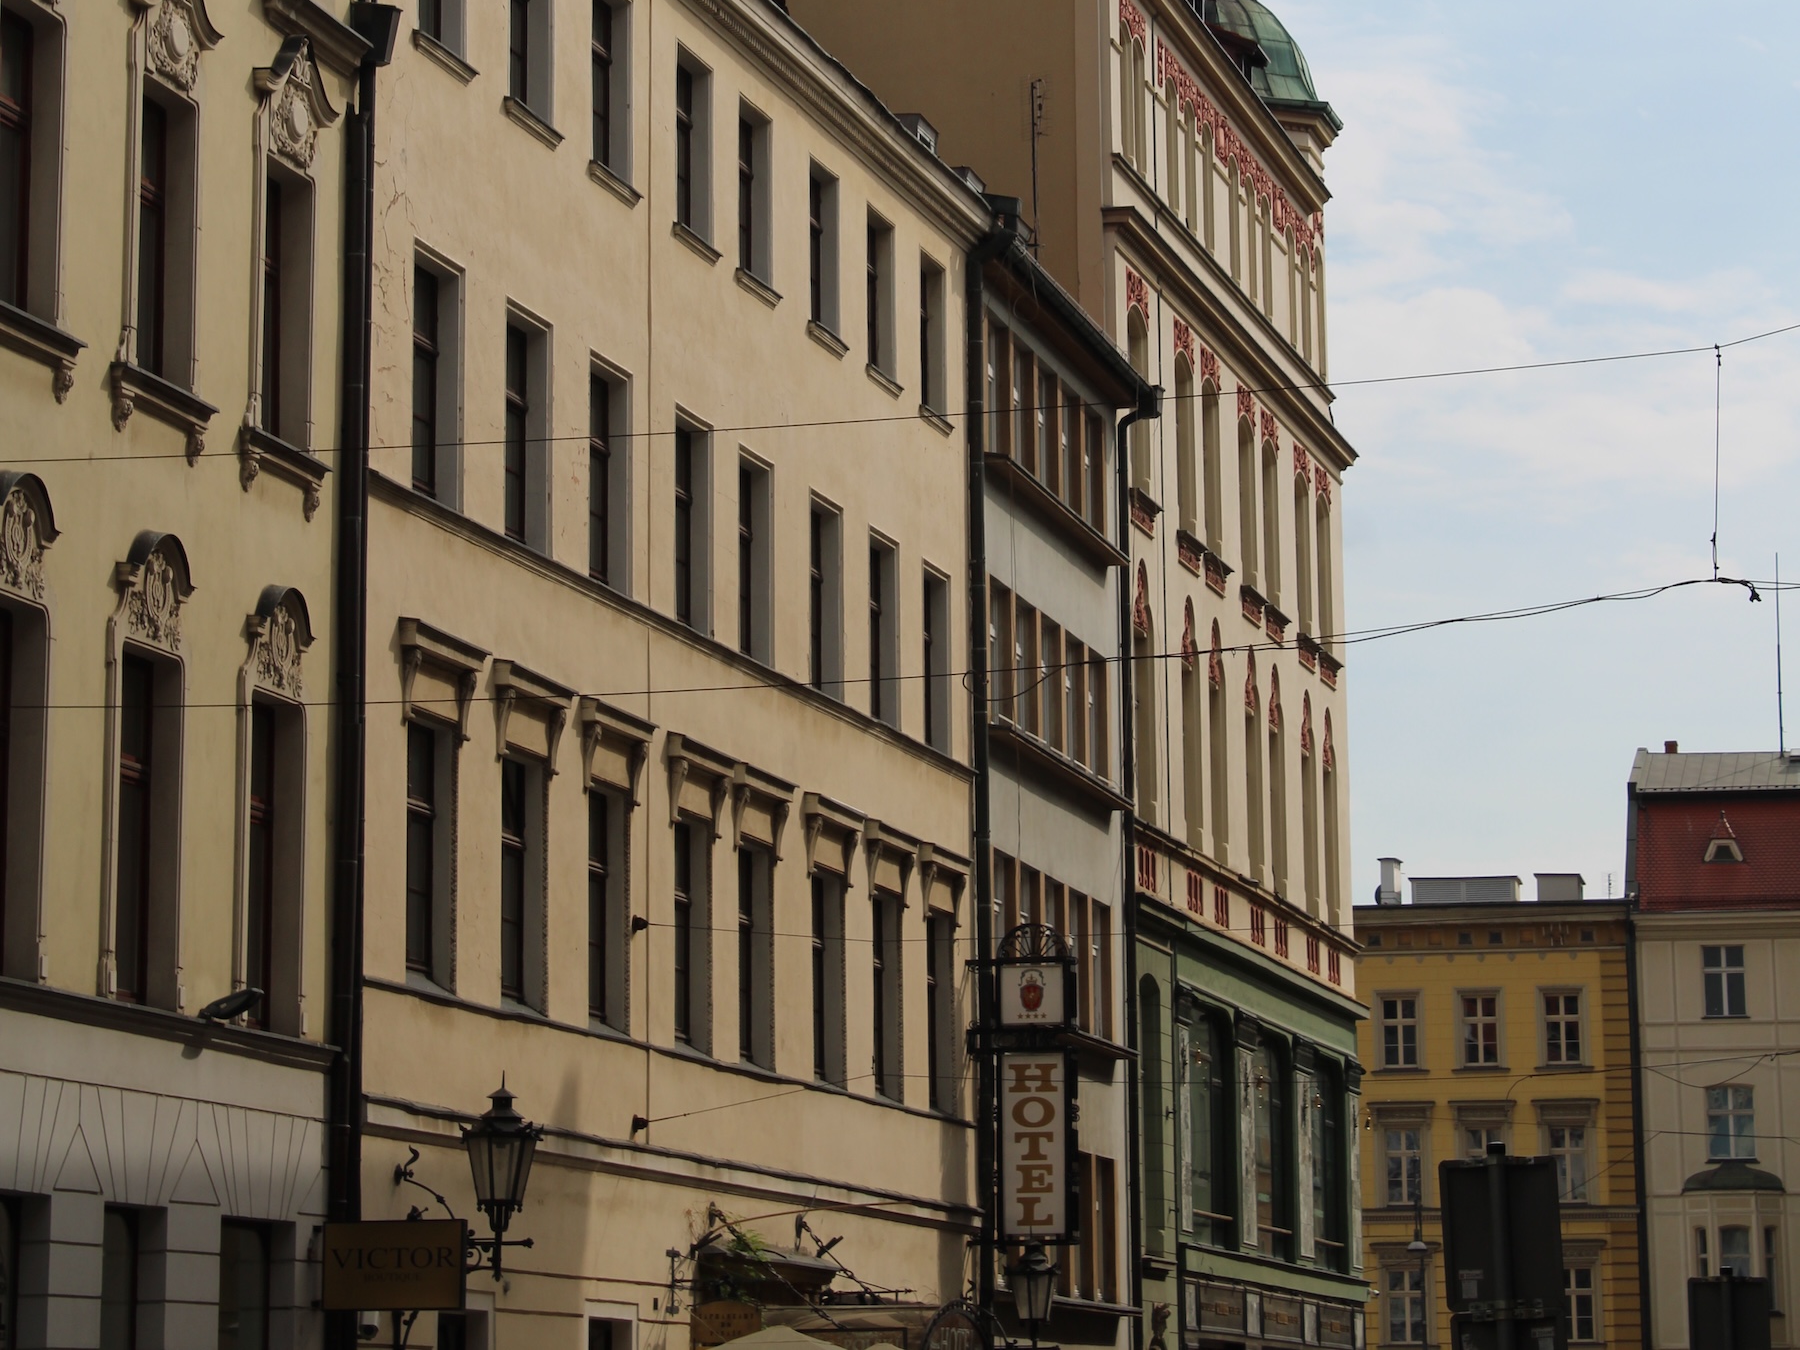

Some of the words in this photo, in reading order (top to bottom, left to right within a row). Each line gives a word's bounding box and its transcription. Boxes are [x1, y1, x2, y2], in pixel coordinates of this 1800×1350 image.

[1008, 1063, 1058, 1226] HOTEL
[331, 1247, 456, 1269] VICTOR
[364, 1272, 421, 1283] BOUTIQUE
